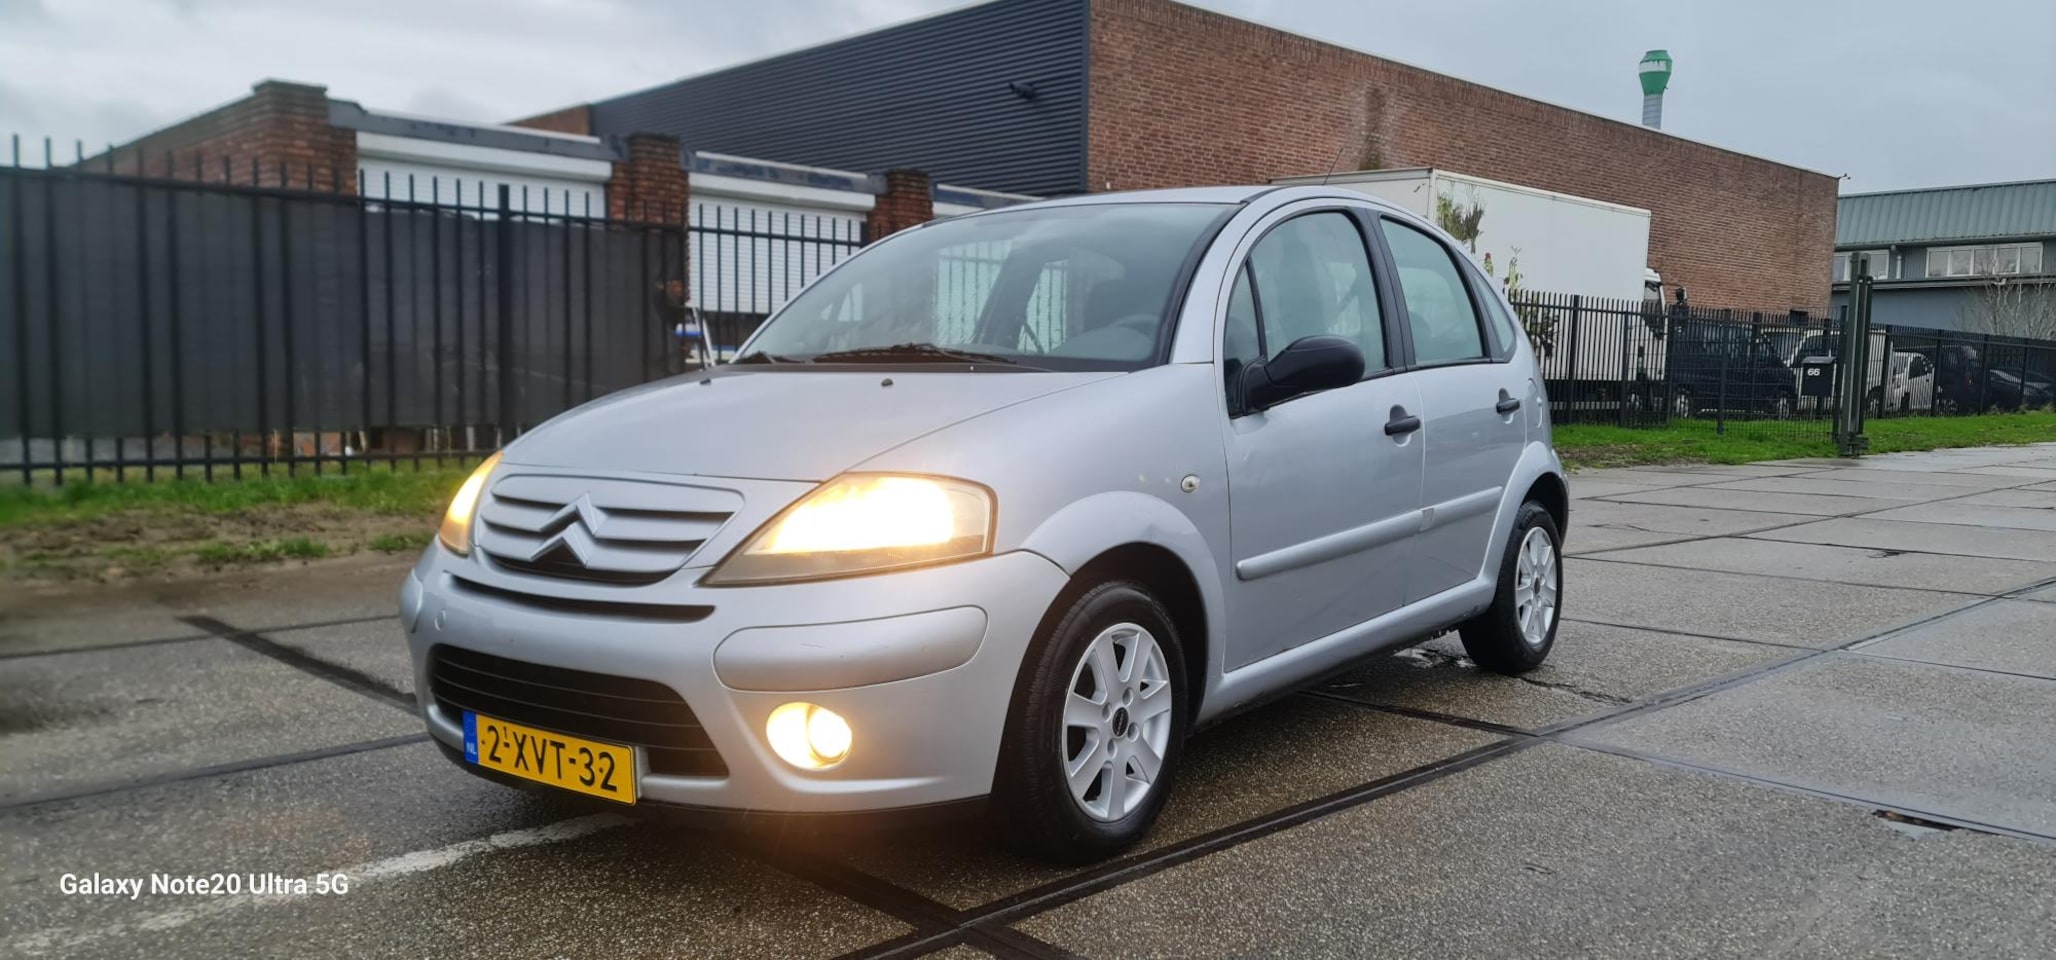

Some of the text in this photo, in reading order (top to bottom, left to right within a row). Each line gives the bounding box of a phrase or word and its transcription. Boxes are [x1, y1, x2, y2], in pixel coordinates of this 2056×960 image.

[1807, 368, 1820, 376] 66
[466, 725, 618, 793] NL 2-XVT-32
